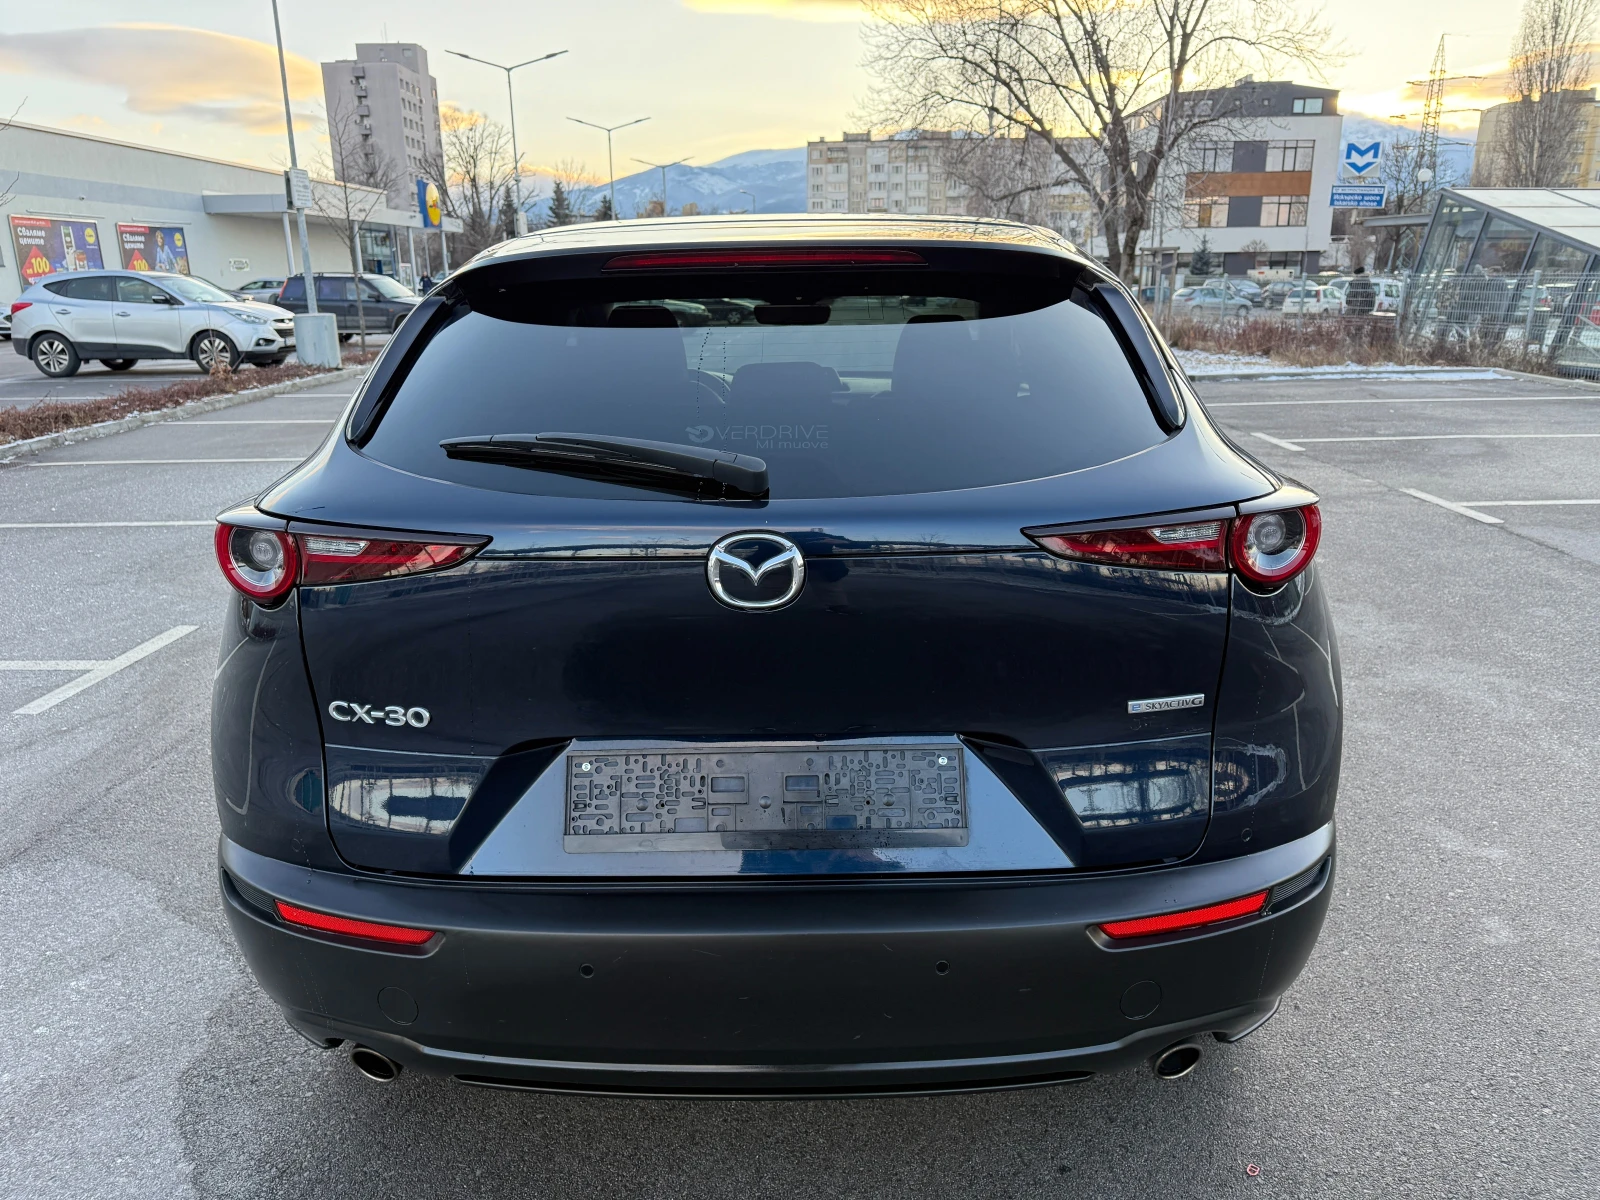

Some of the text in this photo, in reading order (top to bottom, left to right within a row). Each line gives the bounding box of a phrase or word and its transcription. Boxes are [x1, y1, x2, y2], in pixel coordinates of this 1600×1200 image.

[31, 256, 50, 273] 100
[133, 259, 149, 271] 100
[778, 440, 829, 449] muove
[328, 700, 431, 728] CX-30
